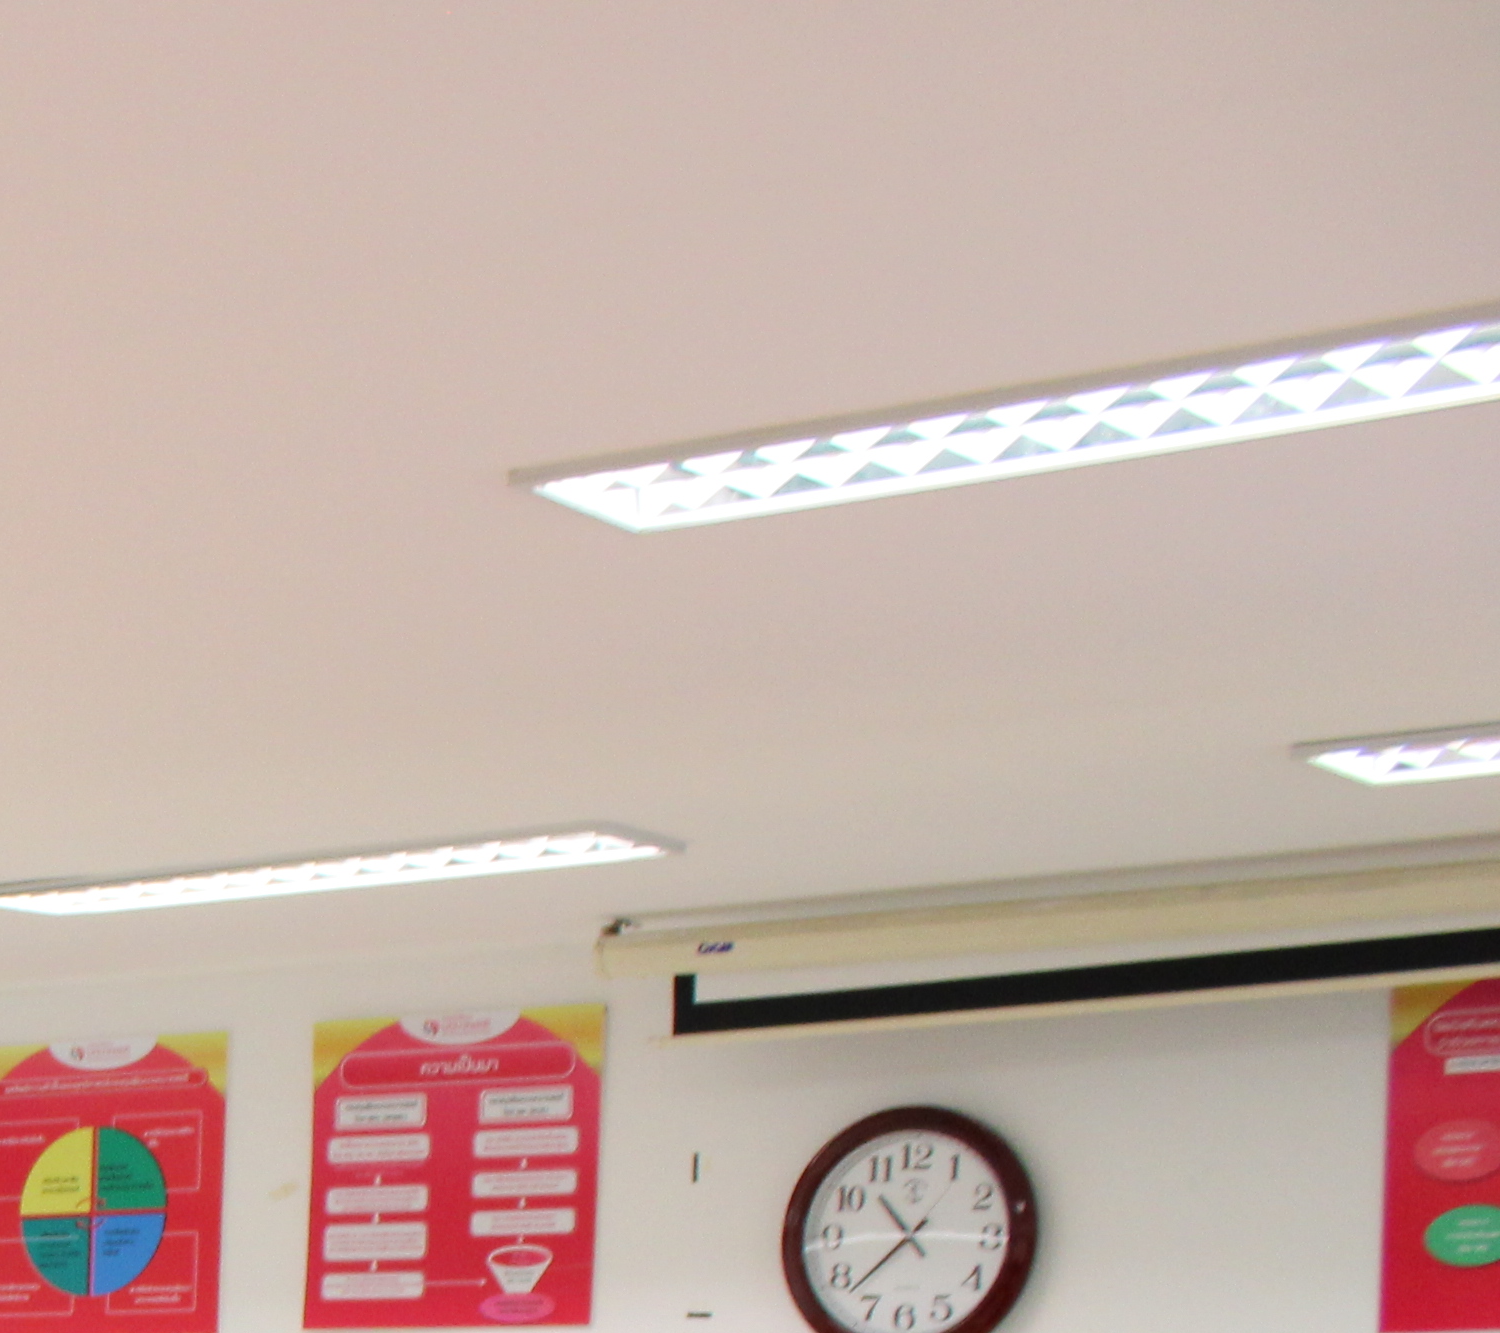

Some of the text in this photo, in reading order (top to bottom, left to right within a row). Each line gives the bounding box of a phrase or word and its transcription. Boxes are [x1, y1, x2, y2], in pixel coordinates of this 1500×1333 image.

[420, 1054, 500, 1076] ความเป็นมา
[869, 1155, 894, 1183] 11
[901, 1143, 934, 1170] 12
[949, 1154, 961, 1181] 1
[837, 1185, 865, 1212] 10
[971, 1184, 993, 1211] 2
[822, 1224, 843, 1250] 9
[978, 1223, 1003, 1250] 3
[830, 1263, 852, 1289] 8
[961, 1264, 983, 1291] 4
[861, 1294, 883, 1322] 7
[894, 1303, 916, 1330] 6
[930, 1294, 954, 1321] 5
